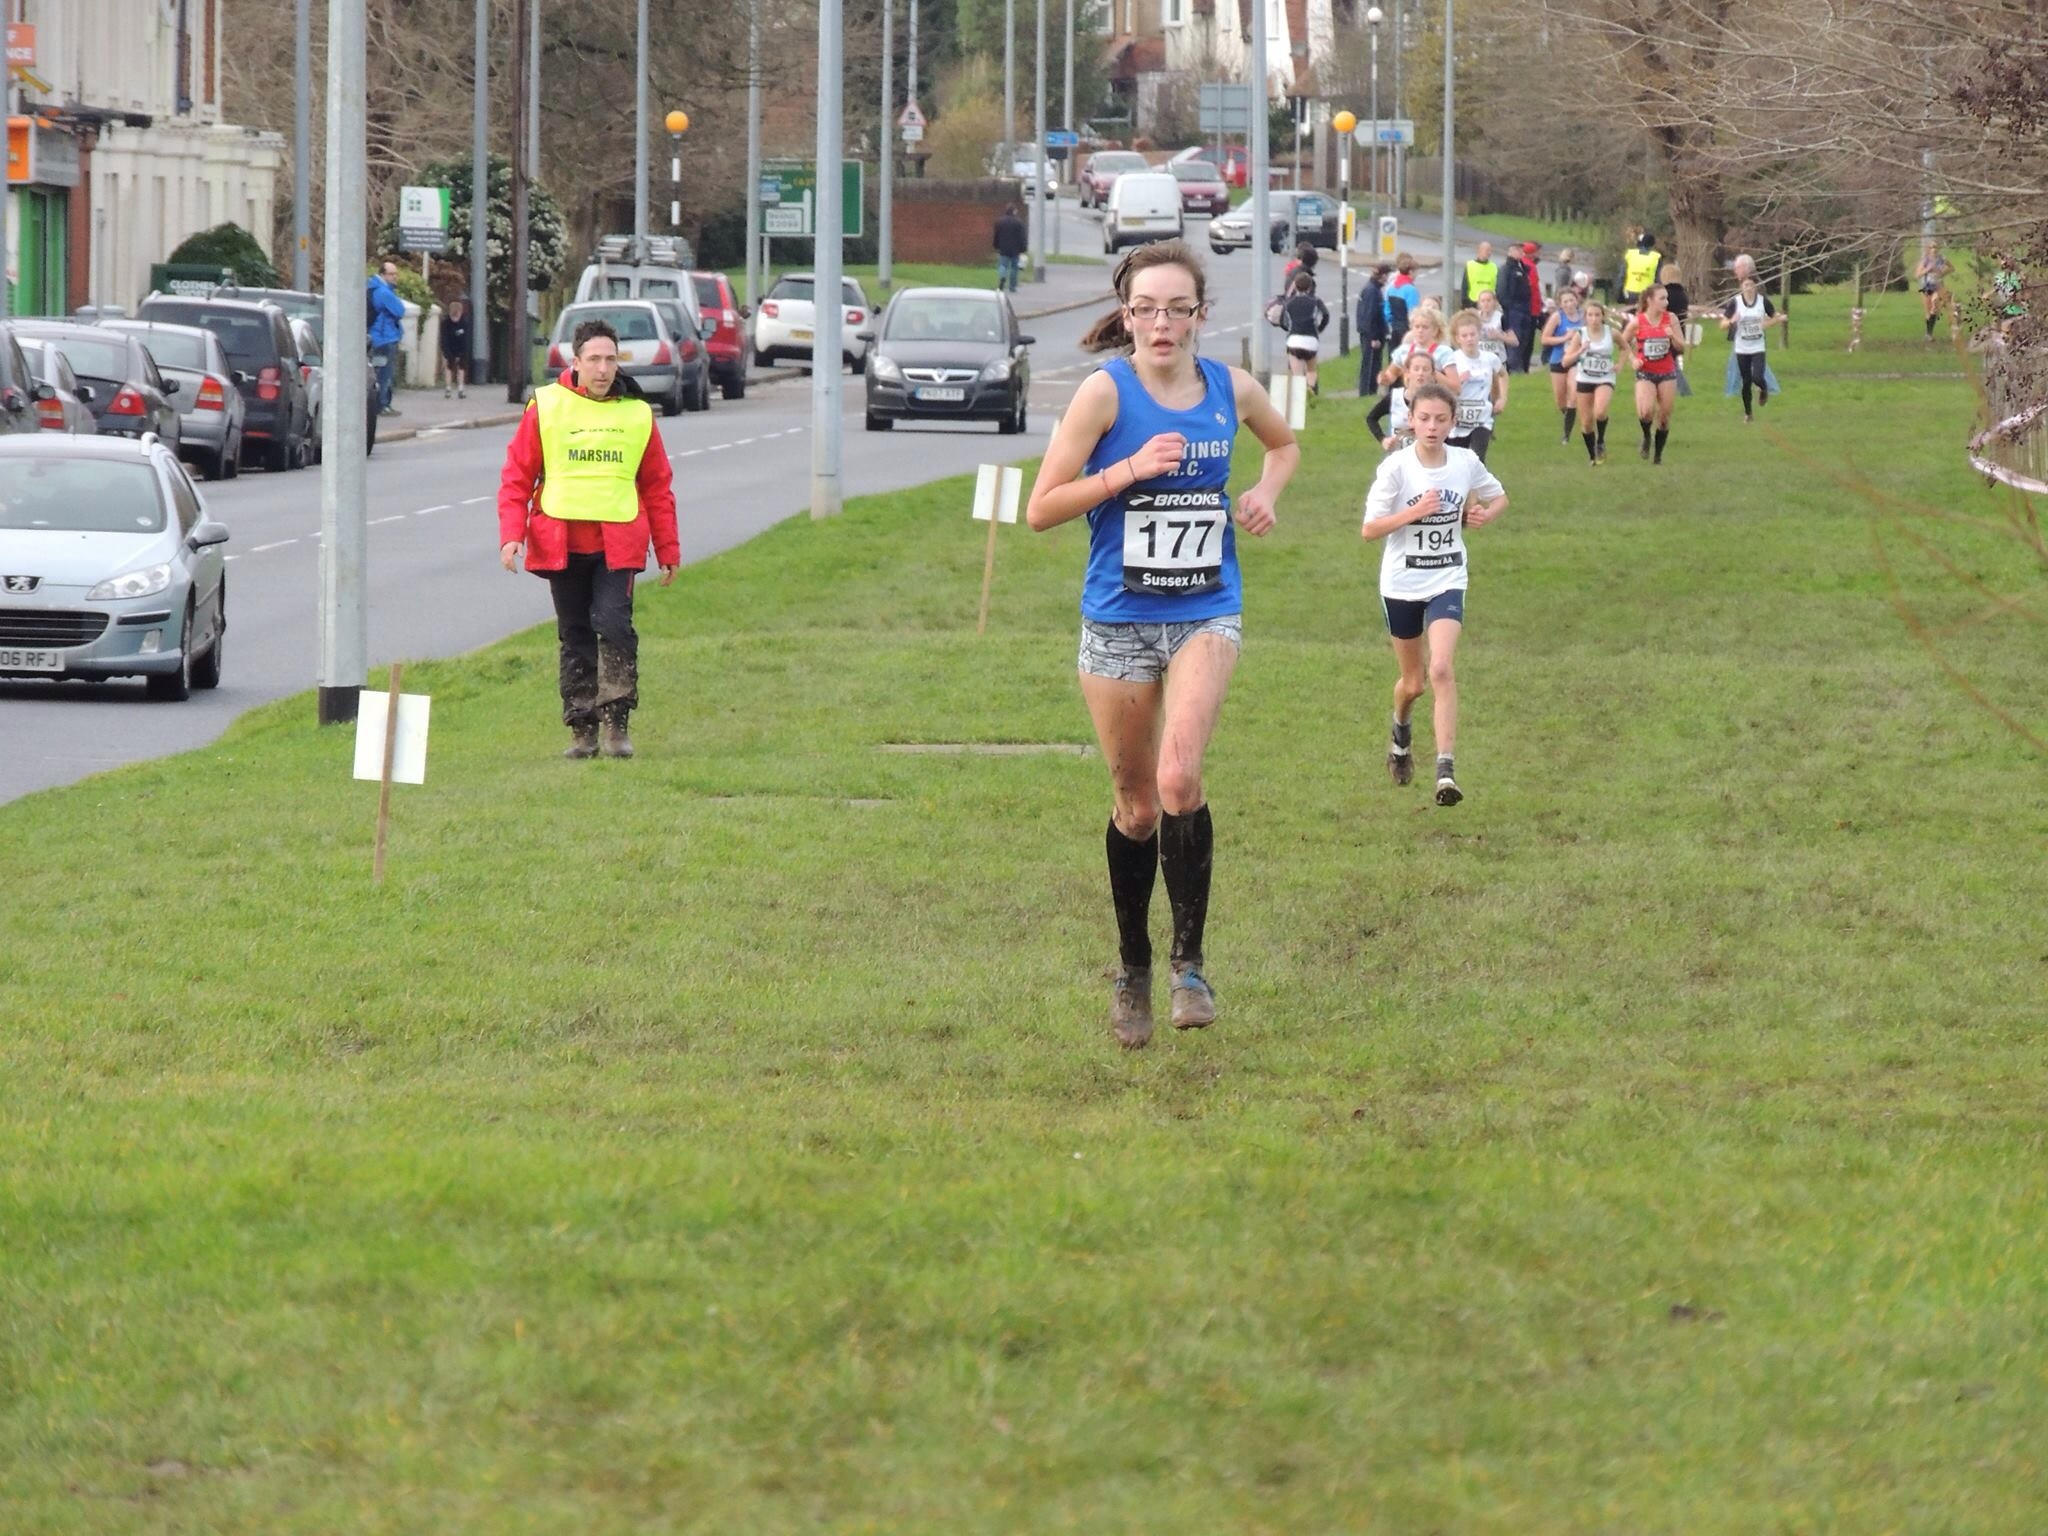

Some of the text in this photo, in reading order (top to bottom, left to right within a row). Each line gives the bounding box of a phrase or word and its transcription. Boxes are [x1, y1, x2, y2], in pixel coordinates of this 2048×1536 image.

[1588, 360, 1607, 370] 170
[1460, 408, 1483, 420] 187
[568, 448, 624, 463] MARSHAL
[1182, 440, 1229, 459] TINGS
[1153, 493, 1221, 506] BROOKS
[1138, 519, 1216, 559] 177
[1413, 527, 1455, 551] 194
[1415, 555, 1454, 566] Sussex AA
[1142, 572, 1207, 587] Sussex AA
[0, 651, 58, 668] 06 RFJ
